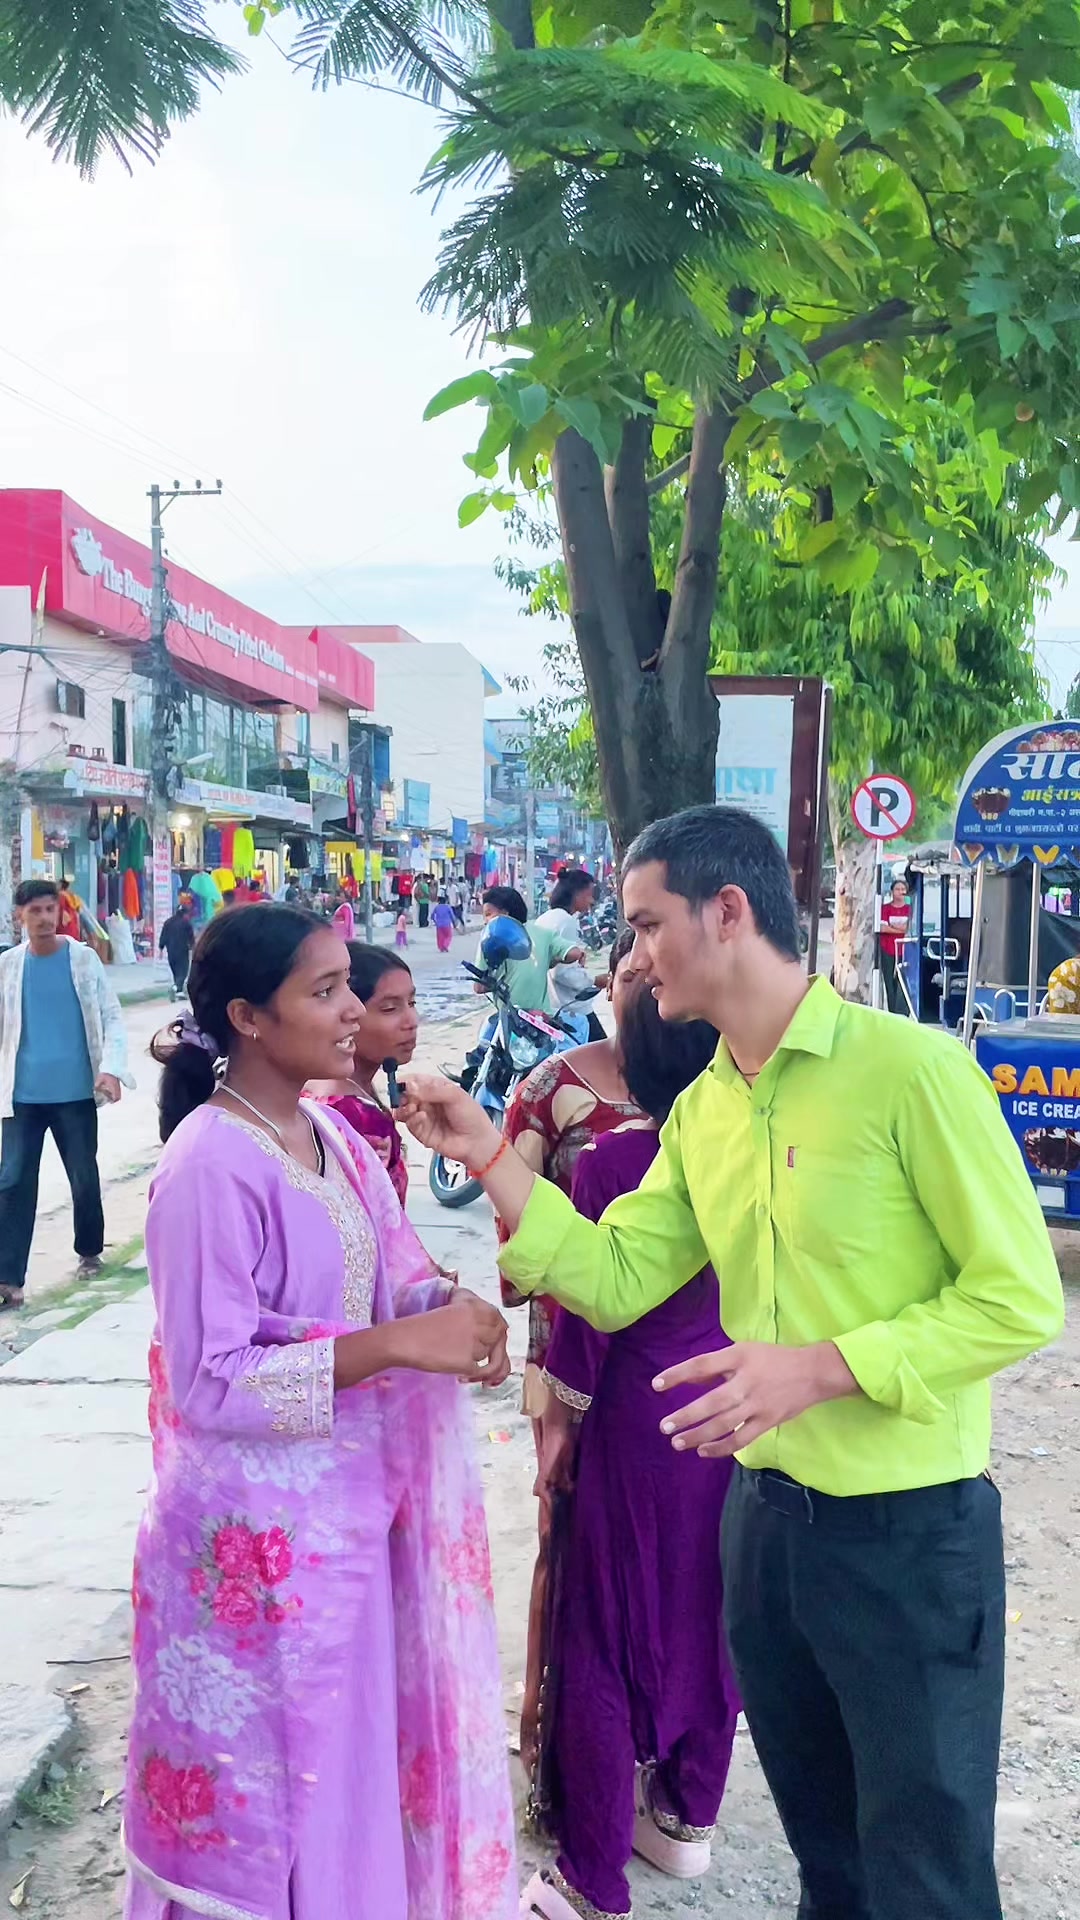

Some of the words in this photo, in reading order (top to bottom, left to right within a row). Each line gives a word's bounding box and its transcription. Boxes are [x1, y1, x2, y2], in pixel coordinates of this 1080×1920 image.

[103, 557, 123, 595] The
[870, 787, 899, 827] P
[1013, 1100, 1038, 1117] ICE
